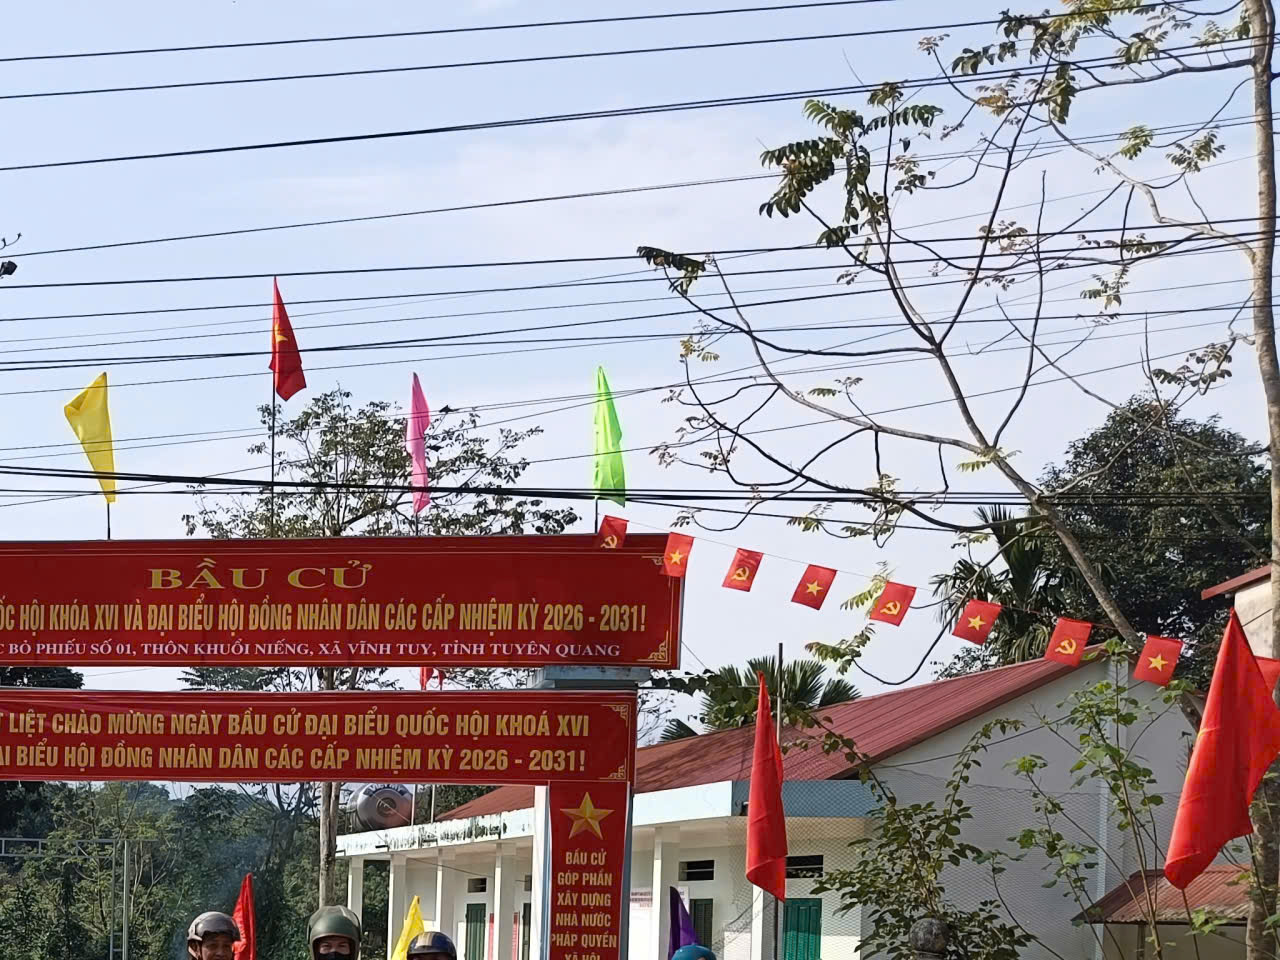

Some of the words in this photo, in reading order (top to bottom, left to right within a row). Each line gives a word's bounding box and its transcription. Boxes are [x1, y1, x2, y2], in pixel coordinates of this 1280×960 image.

[147, 558, 269, 589] BẦU
[287, 560, 372, 588] CỬ
[20, 599, 44, 636] HỘI
[49, 599, 90, 631] KHÓA
[94, 604, 118, 631] XVI
[124, 599, 142, 631] VÀ
[148, 604, 173, 636] ĐẠI
[178, 593, 213, 631] BIỂU
[218, 599, 244, 636] HỘI
[249, 595, 292, 631] ĐỒNG
[297, 598, 341, 630] NHÂN
[347, 598, 379, 630] DÂN
[385, 598, 417, 630] CÁC
[422, 594, 454, 630] CẤP
[459, 598, 512, 636] NHIỆM
[518, 598, 539, 630] KỲ
[544, 604, 583, 631] 2026
[600, 604, 646, 632] 2031!
[9, 639, 31, 655] BỎ
[36, 638, 85, 655] PHIẾU
[90, 638, 112, 655] SỐ
[116, 643, 136, 657] 01,
[141, 640, 189, 655] THÔN
[255, 638, 314, 657] NIẾNG,
[319, 640, 341, 655] XÃ
[348, 640, 390, 655] VĨNH
[396, 643, 436, 657] TUY,
[441, 639, 484, 655] TỈNH
[490, 640, 550, 656] TUYÊN
[555, 643, 620, 657] QUANG
[9, 708, 46, 738] LIỆT
[52, 709, 102, 734] CHÀO
[108, 709, 164, 735] MỪNG
[170, 710, 222, 735] NGÀY
[228, 707, 267, 735] BẦU
[273, 707, 301, 735] CỬ
[305, 713, 338, 740] ĐẠI
[344, 705, 389, 736] BIỂU
[396, 706, 449, 738] QUỐC
[456, 709, 489, 740] HỘI
[496, 710, 550, 736] KHOÁ
[557, 715, 589, 737] XVI
[16, 738, 58, 767] BIỂU
[64, 742, 95, 772] HỘI
[101, 740, 153, 768] ĐỒNG
[159, 743, 212, 768] NHÂN
[218, 743, 258, 769] DÂN
[265, 743, 303, 769] CÁC
[310, 740, 349, 769] CẤP
[355, 743, 421, 774] NHIỆM
[427, 744, 453, 770] KỲ
[459, 749, 508, 770] 2026
[528, 749, 585, 771] 2031!
[591, 848, 607, 866] CỬ
[557, 870, 579, 886] GÓP
[557, 890, 578, 906] XÂY
[581, 892, 612, 910] DỰNG
[555, 910, 578, 926] NHÀ
[581, 911, 612, 927] NƯỚC
